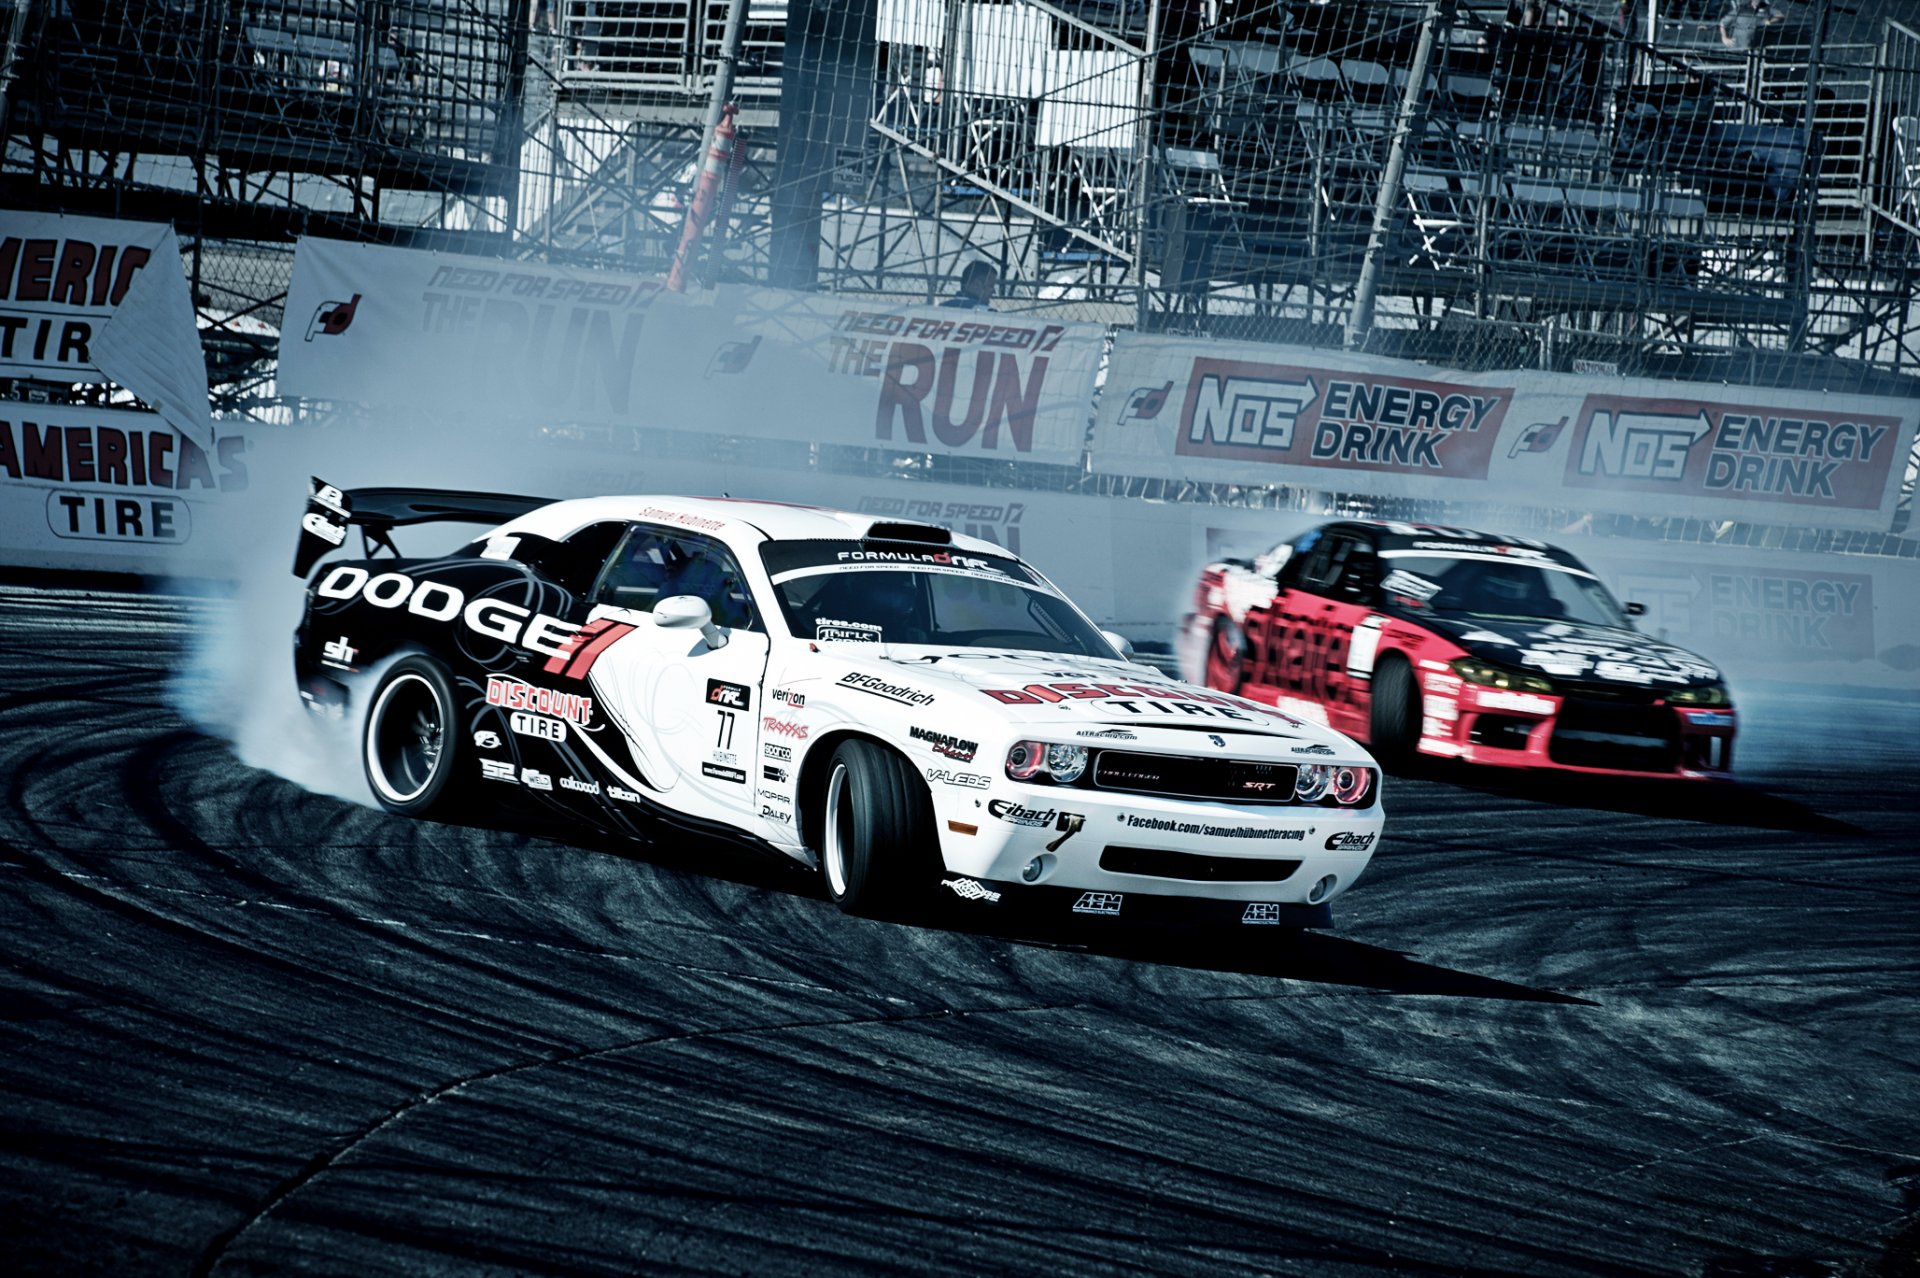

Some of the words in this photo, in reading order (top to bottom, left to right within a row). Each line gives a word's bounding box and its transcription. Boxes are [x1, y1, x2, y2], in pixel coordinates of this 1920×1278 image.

[427, 265, 500, 291] NEED
[499, 272, 551, 298] FOR
[548, 278, 632, 305] SPEED
[422, 293, 479, 334] THE
[835, 310, 903, 336] NEED
[902, 317, 957, 341] FOR
[956, 322, 1036, 349] SPEED
[828, 335, 883, 377] THE
[875, 342, 1050, 453] RUN
[1189, 374, 1319, 451] NOS
[1320, 380, 1501, 433] ENERGY
[1310, 420, 1451, 468] DRINK
[1579, 409, 1712, 481] NOS
[1712, 412, 1890, 462] ENERGY
[1703, 452, 1842, 499] DRINK
[59, 495, 176, 539] TIRE
[856, 496, 906, 513] NEED
[905, 499, 942, 517] FOR
[942, 502, 1004, 521] SPEED
[837, 551, 935, 563] FORMULA
[318, 567, 586, 661] DODGE
[1709, 572, 1862, 617] ENERGY
[1711, 609, 1833, 650] DRINK
[485, 675, 594, 725] DISCOUNT
[772, 688, 806, 708] verizon
[841, 672, 936, 706] BFGoodrich
[517, 714, 561, 739] TIRE
[717, 709, 736, 750] 77
[763, 717, 809, 740] TRAXXAS
[1104, 701, 1253, 722] TIRE
[909, 725, 979, 753] MAGNAFLOW
[757, 788, 791, 804] MOPAR
[926, 768, 992, 790] V-LEDS
[1243, 781, 1276, 791] SRT
[988, 799, 1057, 822] Eibach
[1324, 831, 1376, 850] Eibach
